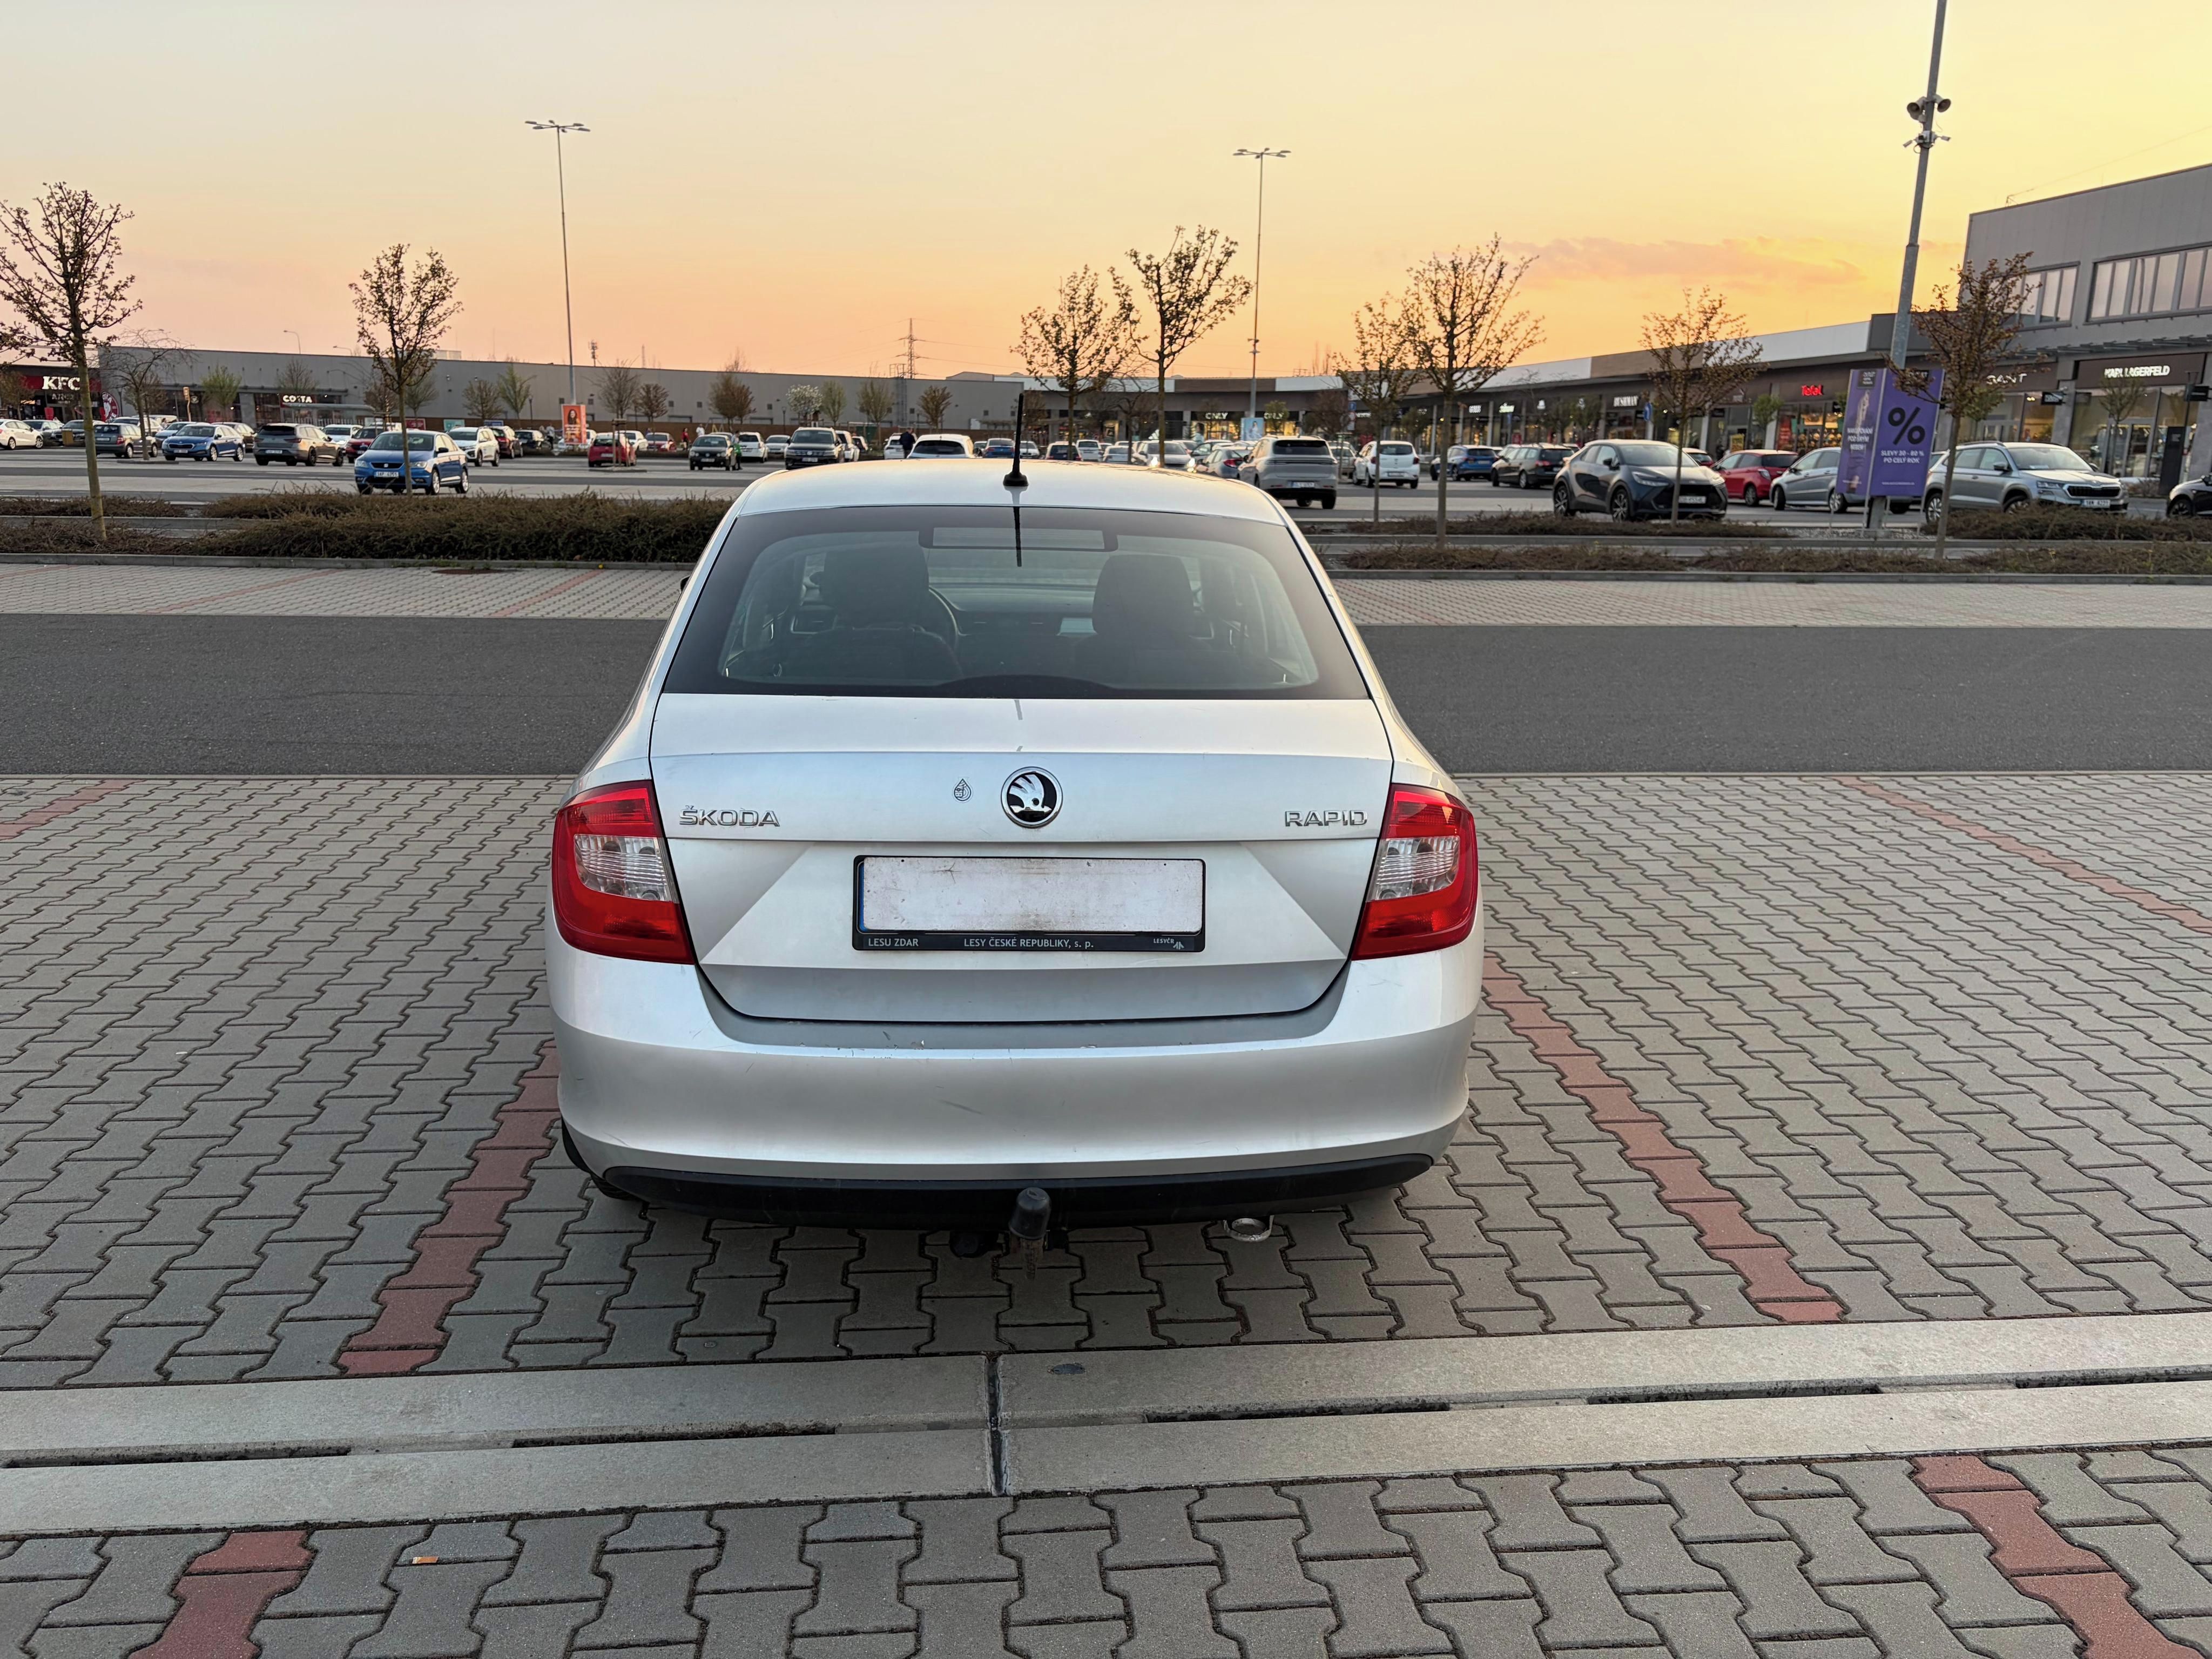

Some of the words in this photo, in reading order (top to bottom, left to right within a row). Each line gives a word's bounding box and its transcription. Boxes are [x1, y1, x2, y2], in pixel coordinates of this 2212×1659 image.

[2124, 365, 2170, 377] LAGERFELD
[42, 376, 80, 391] KFC
[1801, 384, 1823, 396] Tefal
[679, 805, 780, 827] ŠKODA
[1285, 810, 1368, 827] RAPID
[868, 938, 891, 947] LESU
[894, 938, 919, 947] ZDAR
[964, 939, 986, 947] LESY
[989, 936, 1017, 947] ČESKÉ
[1020, 939, 1071, 949] REPUBLIKY,
